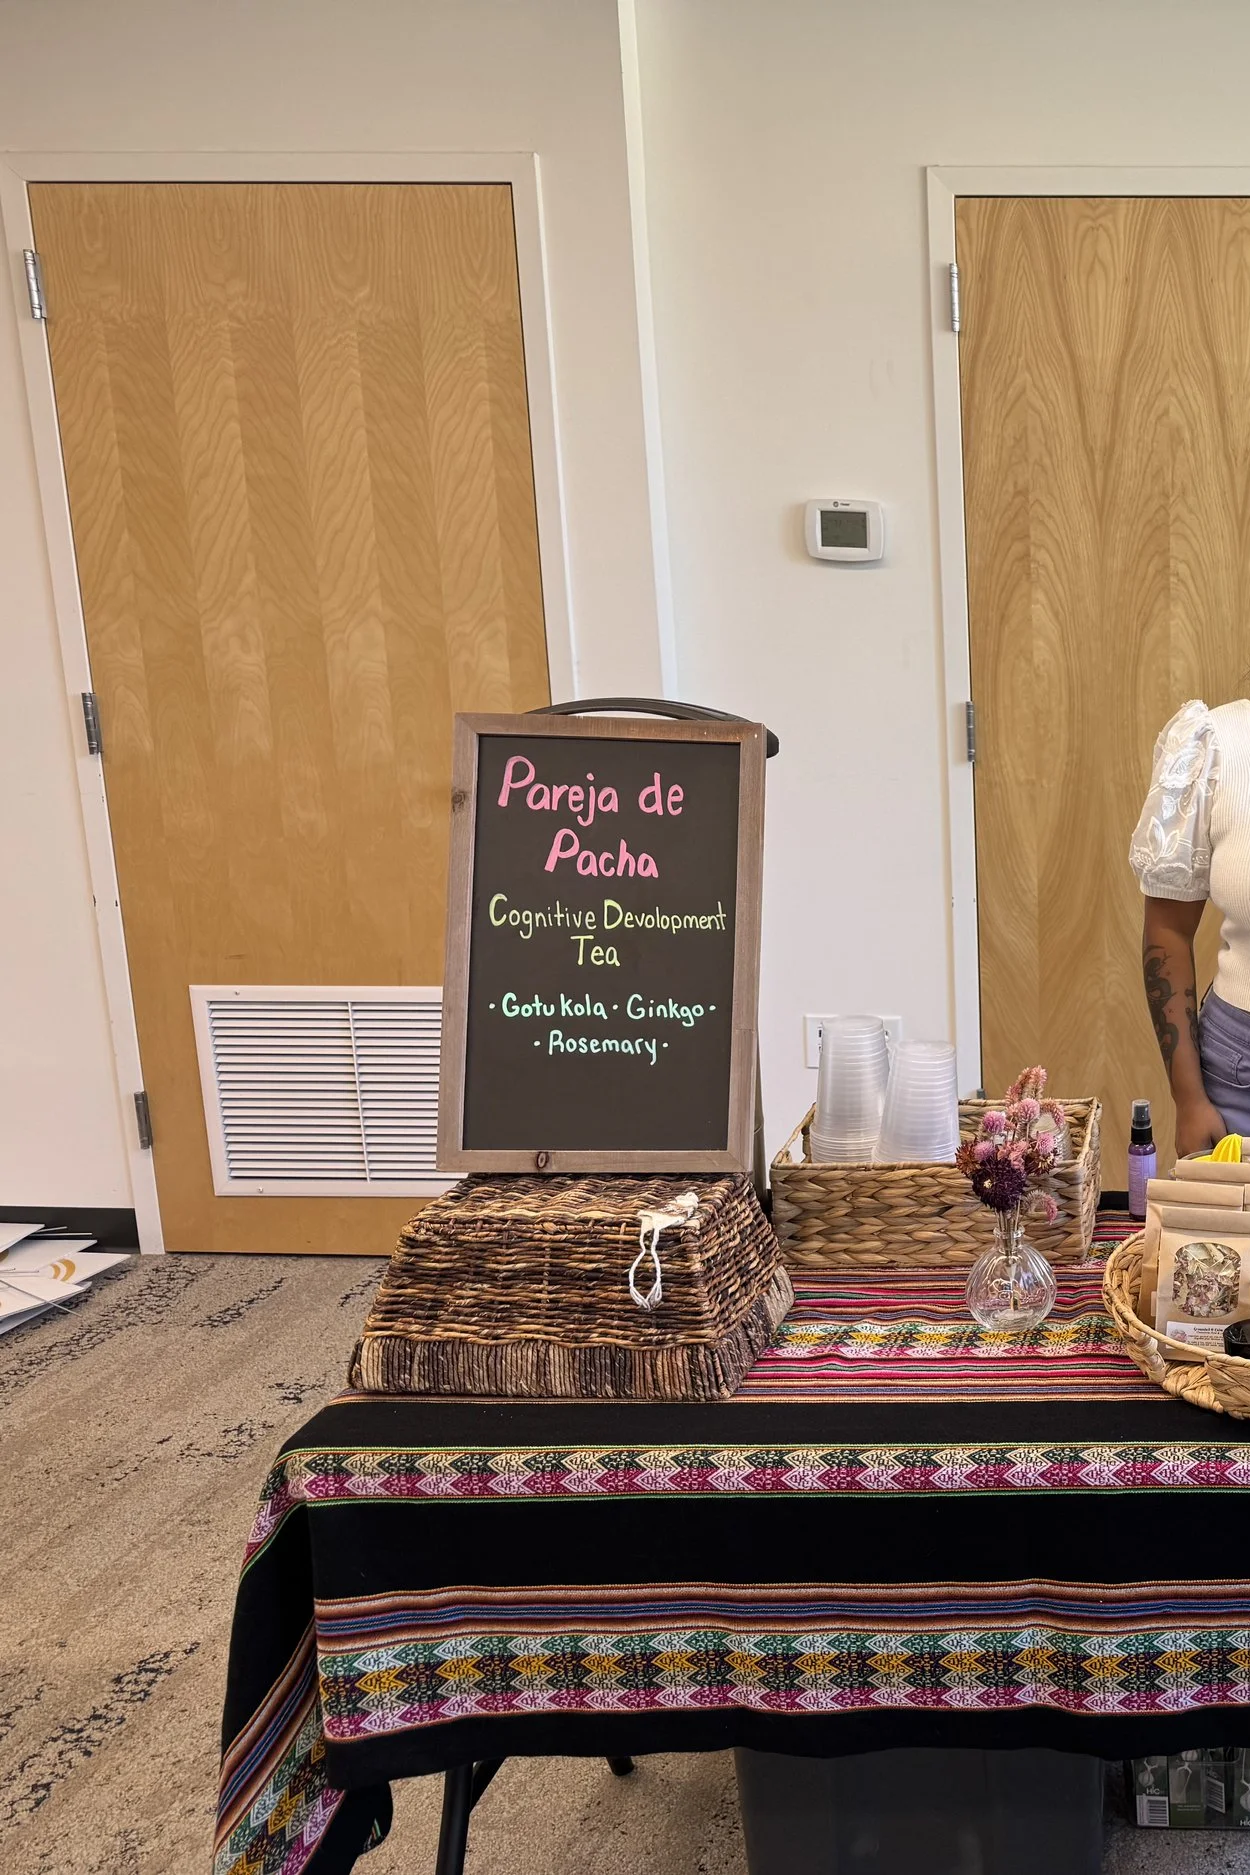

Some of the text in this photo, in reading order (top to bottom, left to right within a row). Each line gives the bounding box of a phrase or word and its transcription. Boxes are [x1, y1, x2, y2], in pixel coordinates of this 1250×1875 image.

[497, 755, 684, 827] Pareja de
[544, 828, 659, 878] Pacha
[489, 893, 727, 939] Cognitive Devolopment
[570, 934, 621, 967] Tea
[501, 992, 555, 1018] Gotu
[626, 993, 705, 1028] Ginkgo
[549, 1029, 657, 1066] Rosemary
